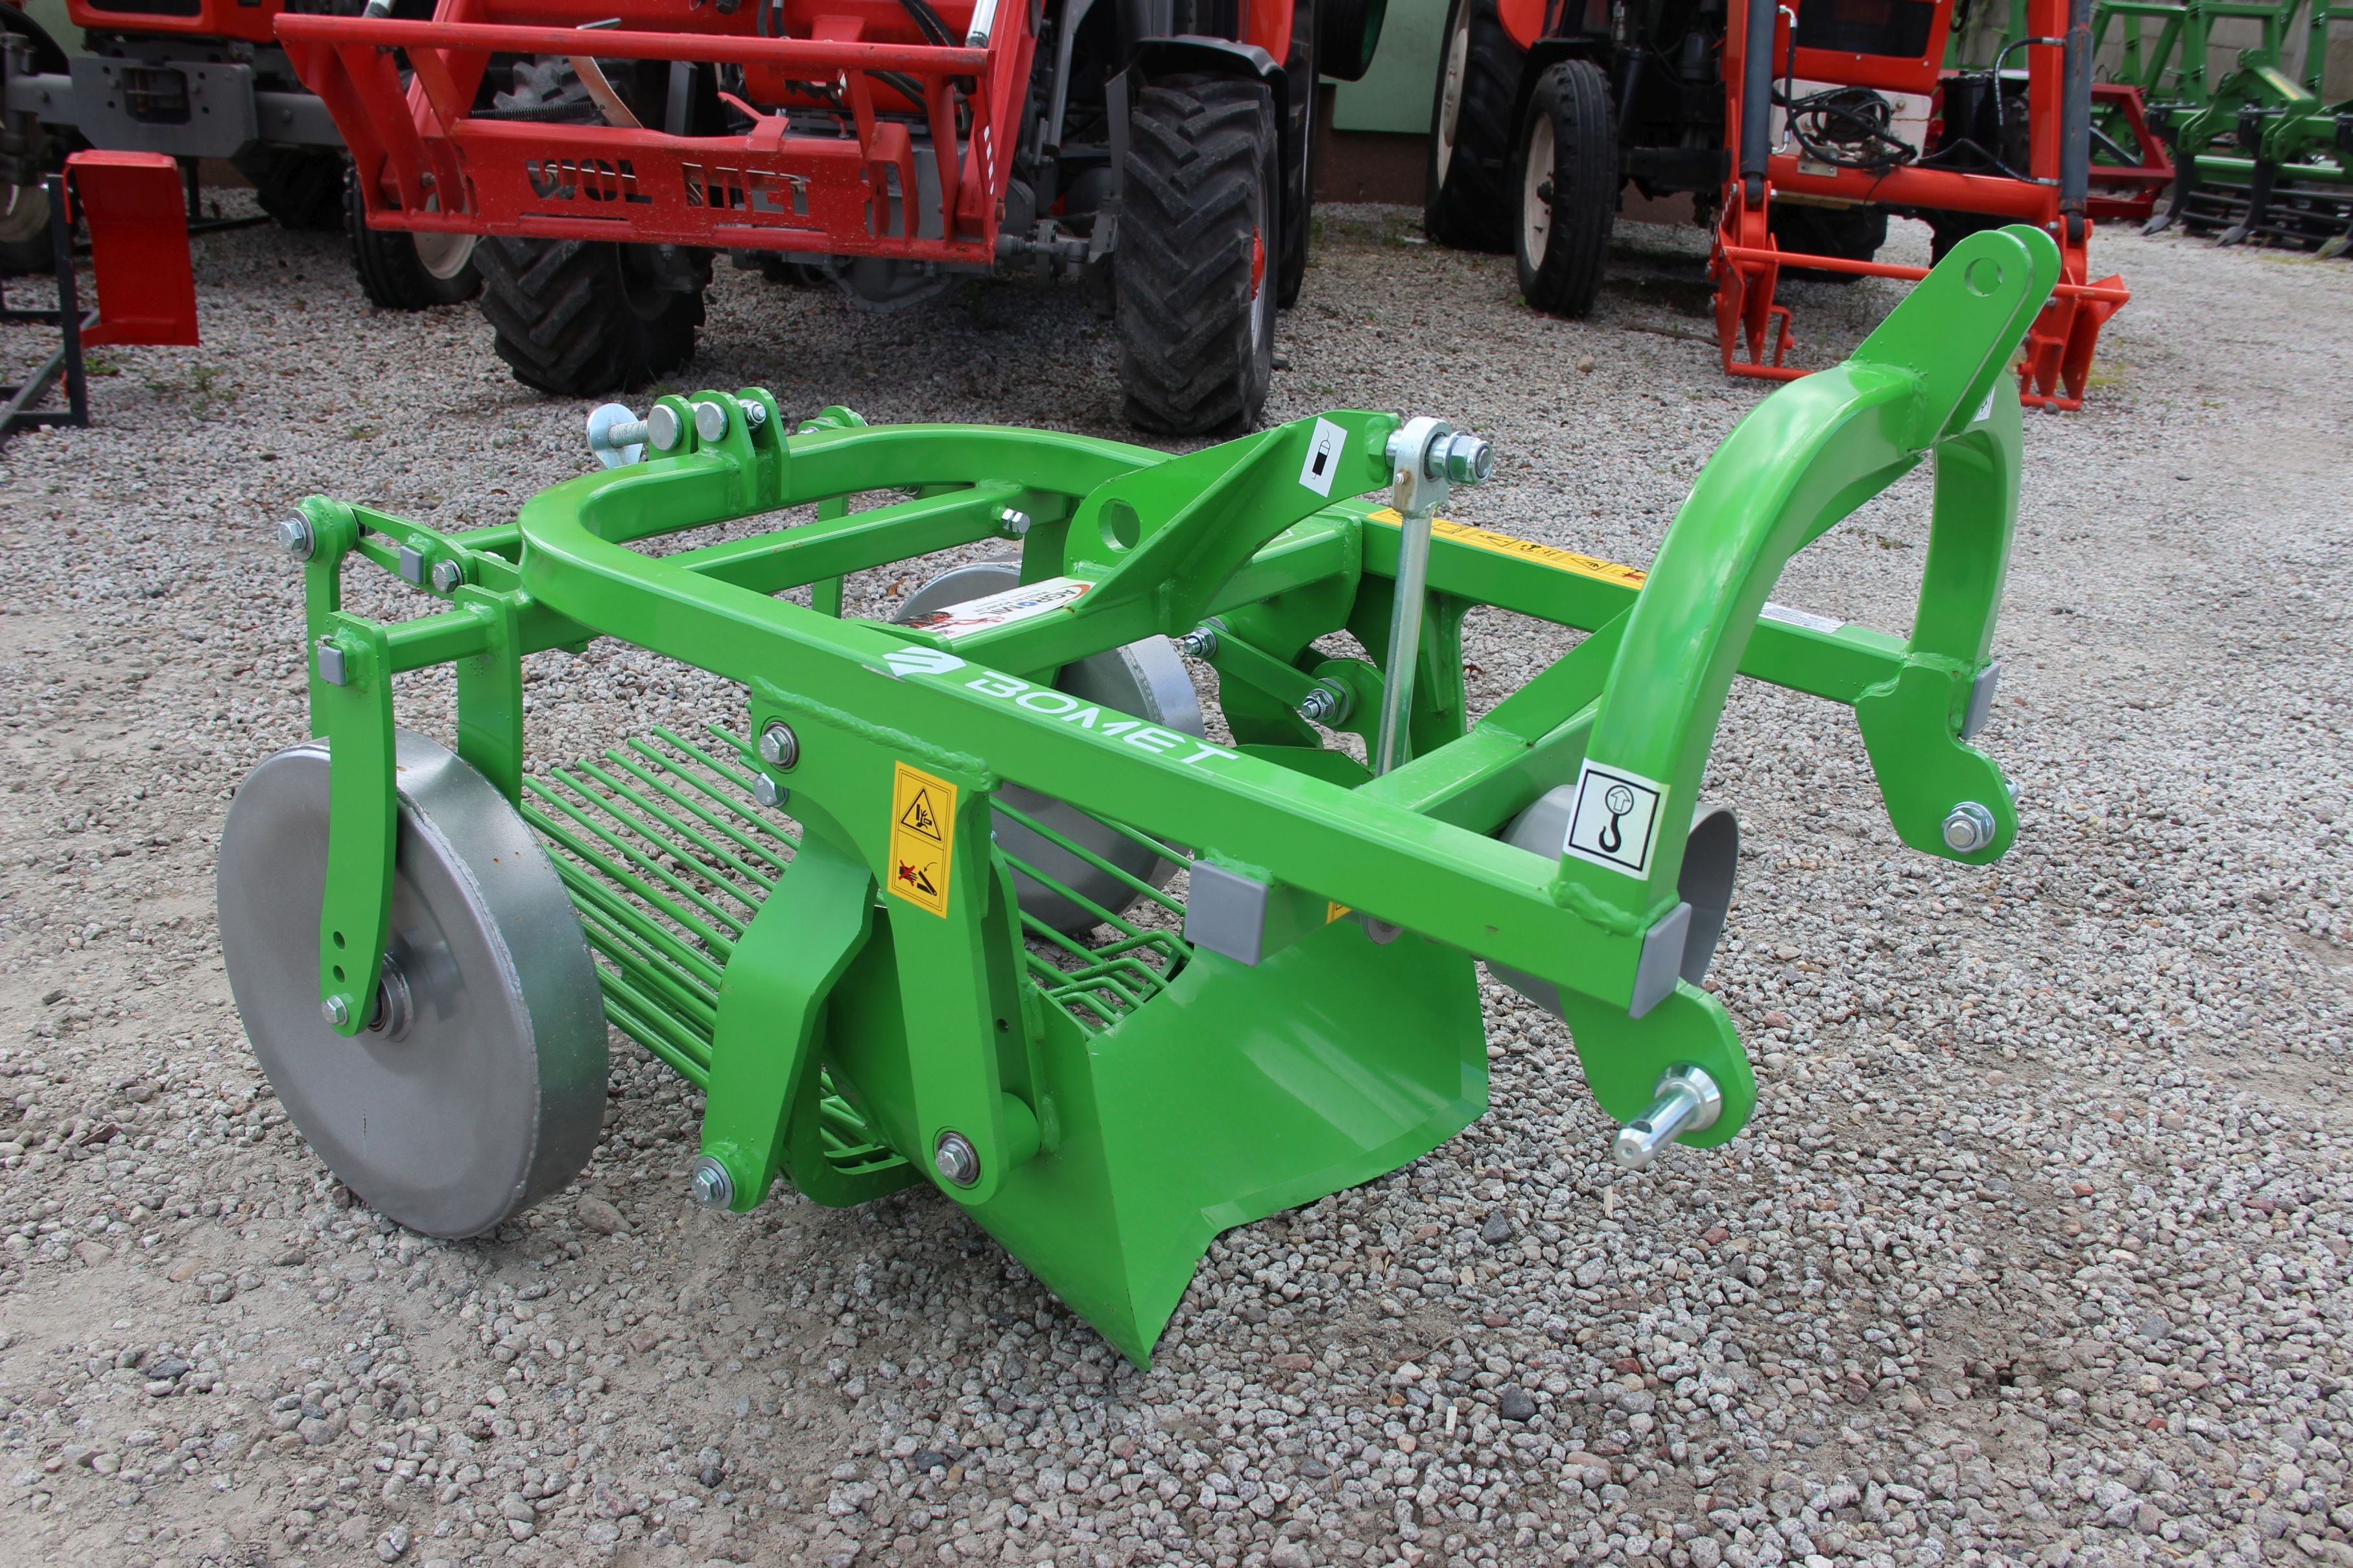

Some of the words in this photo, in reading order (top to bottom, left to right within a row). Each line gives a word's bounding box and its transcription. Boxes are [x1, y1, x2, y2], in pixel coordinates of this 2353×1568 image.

[526, 159, 653, 204] WOL
[681, 161, 812, 216] MET
[965, 670, 1240, 765] BOMET
